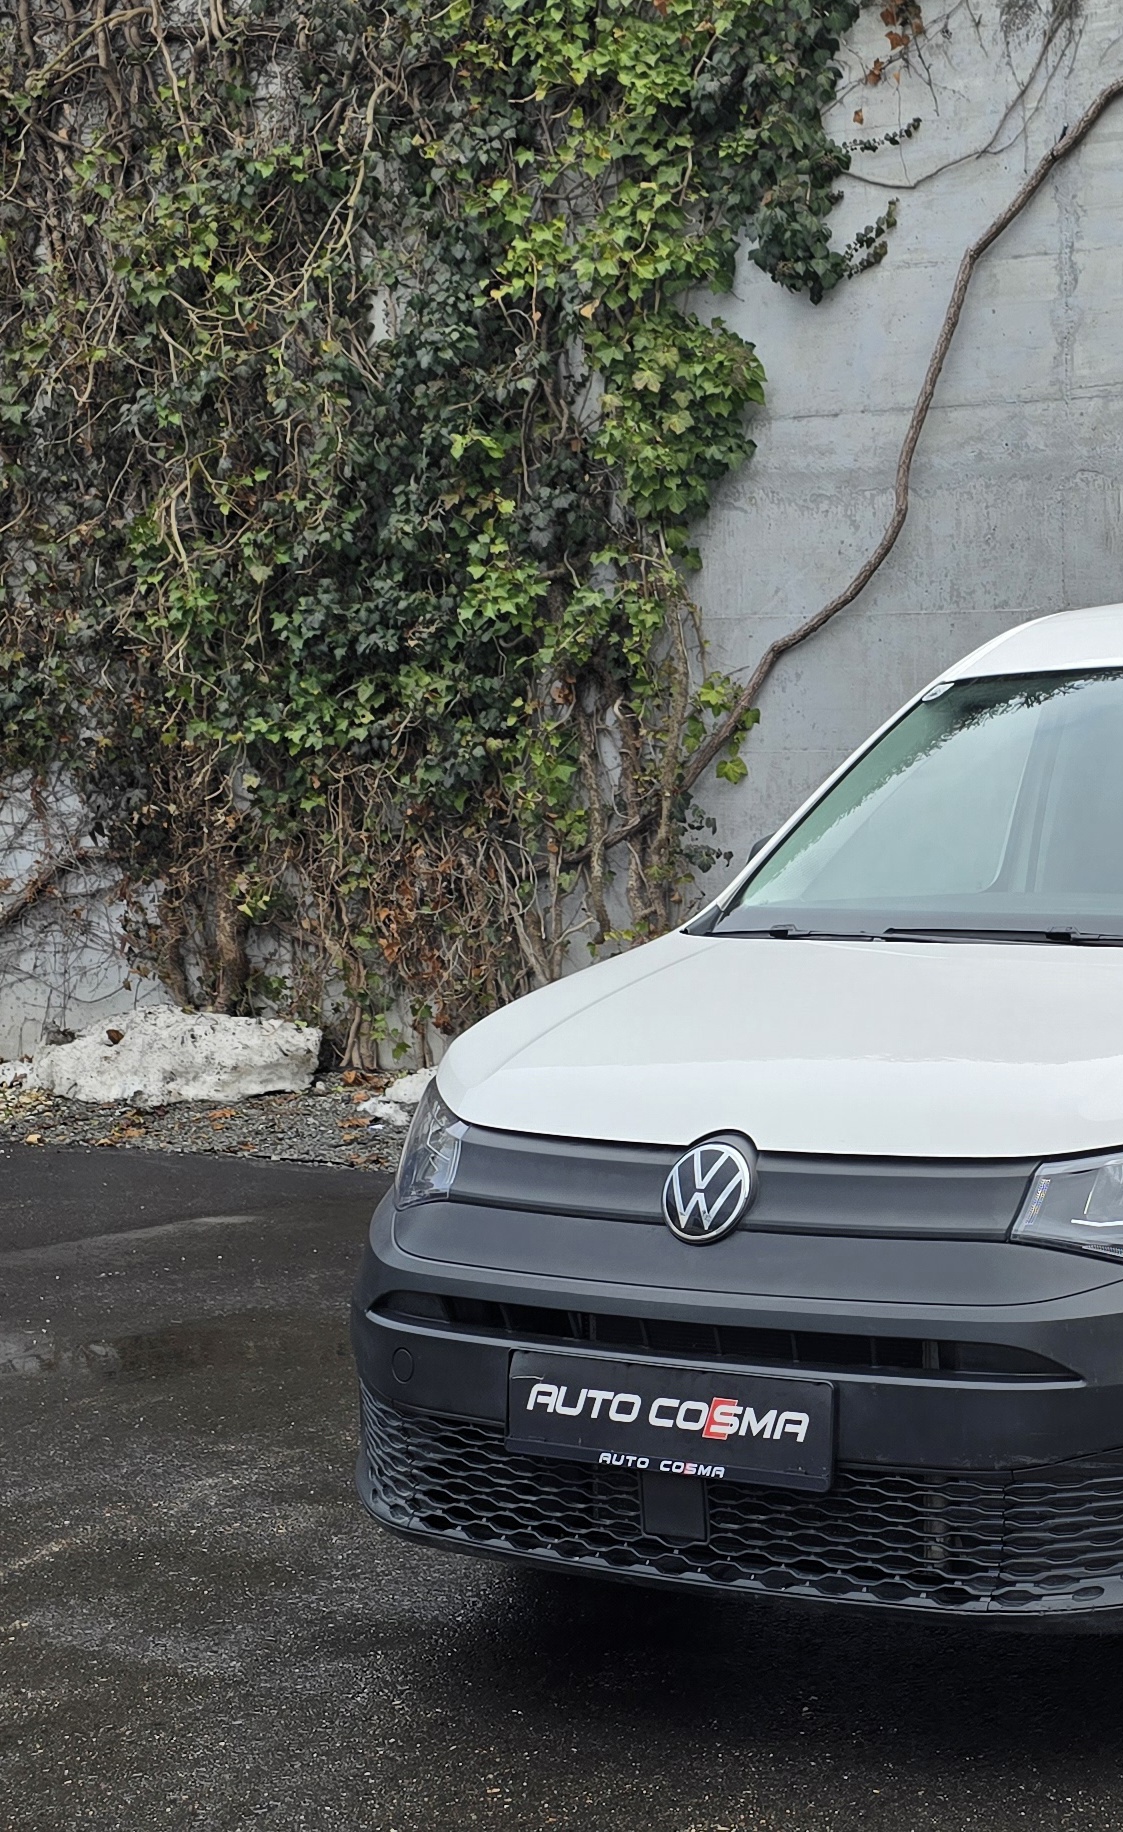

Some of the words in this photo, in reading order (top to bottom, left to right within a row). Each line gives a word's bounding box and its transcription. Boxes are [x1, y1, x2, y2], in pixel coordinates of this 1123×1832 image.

[527, 1383, 642, 1423] AUTO
[648, 1397, 810, 1443] COSMA
[598, 1452, 650, 1469] AUTO
[659, 1460, 726, 1479] COSMA
